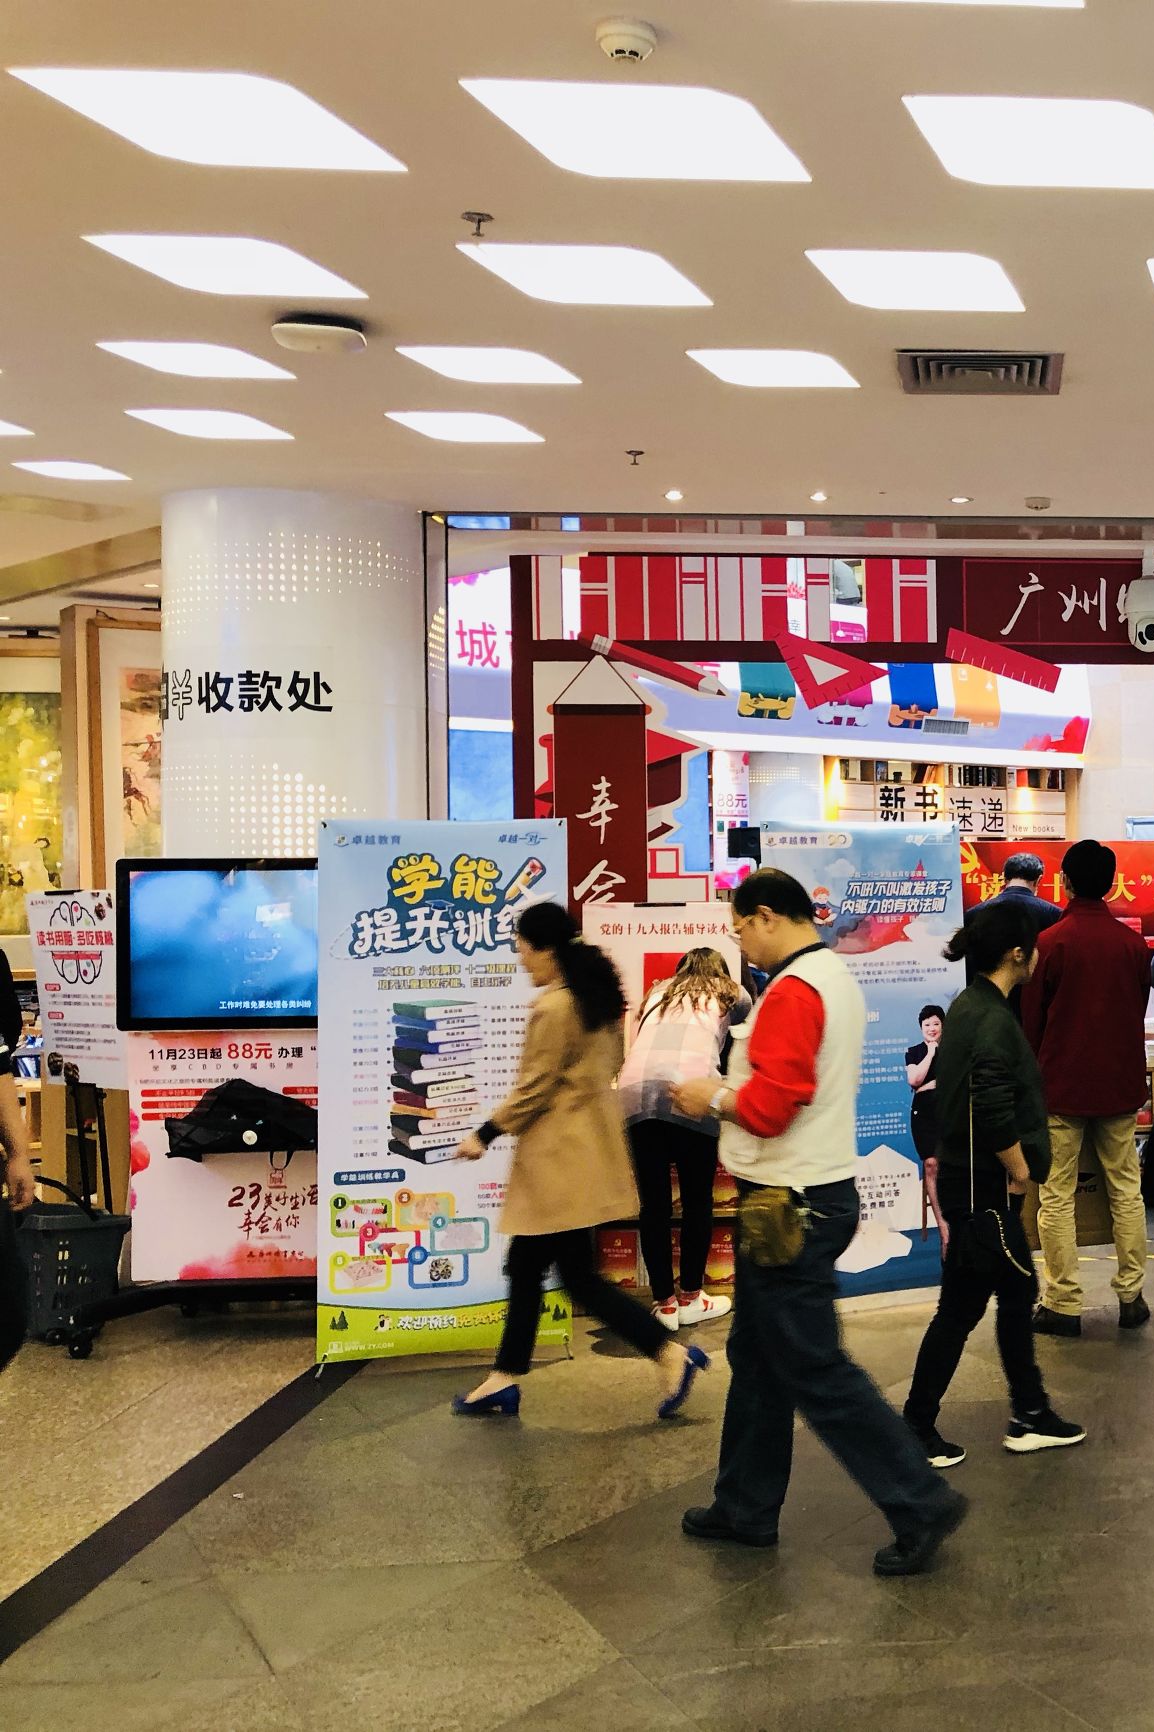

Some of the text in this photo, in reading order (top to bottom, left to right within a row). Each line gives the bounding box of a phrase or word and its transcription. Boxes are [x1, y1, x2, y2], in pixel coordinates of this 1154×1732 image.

[455, 619, 511, 668] 城
[198, 670, 333, 714] 收款处
[1012, 823, 1055, 832] New books
[352, 834, 402, 845] 卓越教育
[778, 836, 818, 845] 卓越教育
[391, 853, 500, 905] 学能
[848, 880, 952, 898] 不吼不叫激发孩子
[841, 898, 946, 916] 内驱力的有效法则
[600, 922, 729, 936] 党的十九大报告辅导读本
[219, 1000, 312, 1010] 工作时难免要处理各类纠纷
[149, 1042, 304, 1061] 11月23日起 88元 办理
[237, 1208, 300, 1241] 幸会有你
